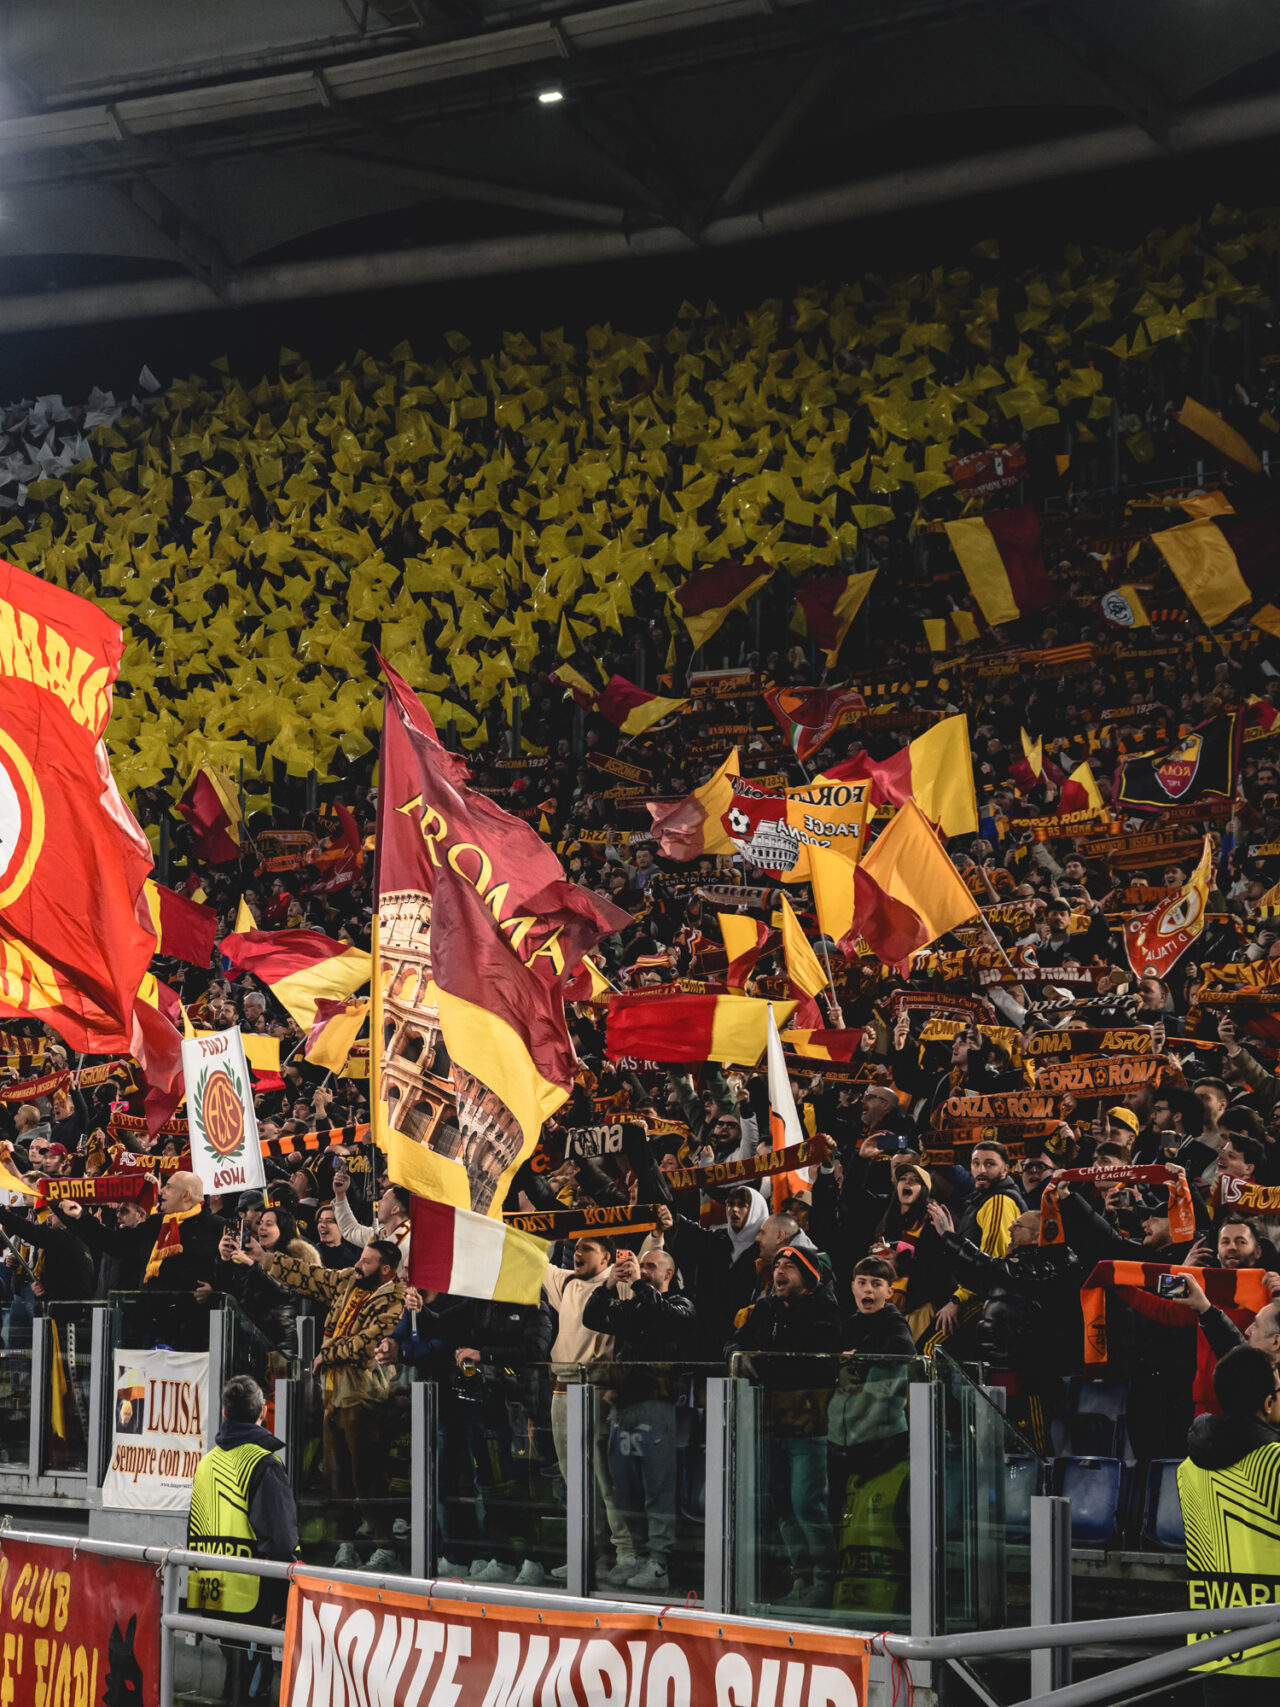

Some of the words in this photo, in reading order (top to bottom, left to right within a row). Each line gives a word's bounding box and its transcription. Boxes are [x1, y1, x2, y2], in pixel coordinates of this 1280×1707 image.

[604, 758, 642, 780] ASROMA
[1060, 808, 1103, 825] ROMA
[393, 793, 565, 975] ROMA
[1027, 1032, 1072, 1053] OMA
[1039, 1068, 1094, 1091] FORZA
[1109, 1061, 1156, 1086] ROMA
[947, 1097, 995, 1118] ORZA
[1007, 1097, 1054, 1118] ROMA
[214, 1166, 246, 1189] ROMA
[670, 1168, 696, 1189] MAI
[704, 1161, 746, 1183] SOLA
[755, 1152, 785, 1174] MAI
[1095, 1169, 1133, 1181] LEAGUE
[48, 1180, 96, 1200] ROMA
[147, 1379, 201, 1435] LUISA
[112, 1444, 156, 1483] sempre
[158, 1445, 181, 1478] con
[11, 1562, 71, 1632] CLUB
[1187, 1579, 1280, 1610] EWAR
[291, 1597, 473, 1707] MONTE
